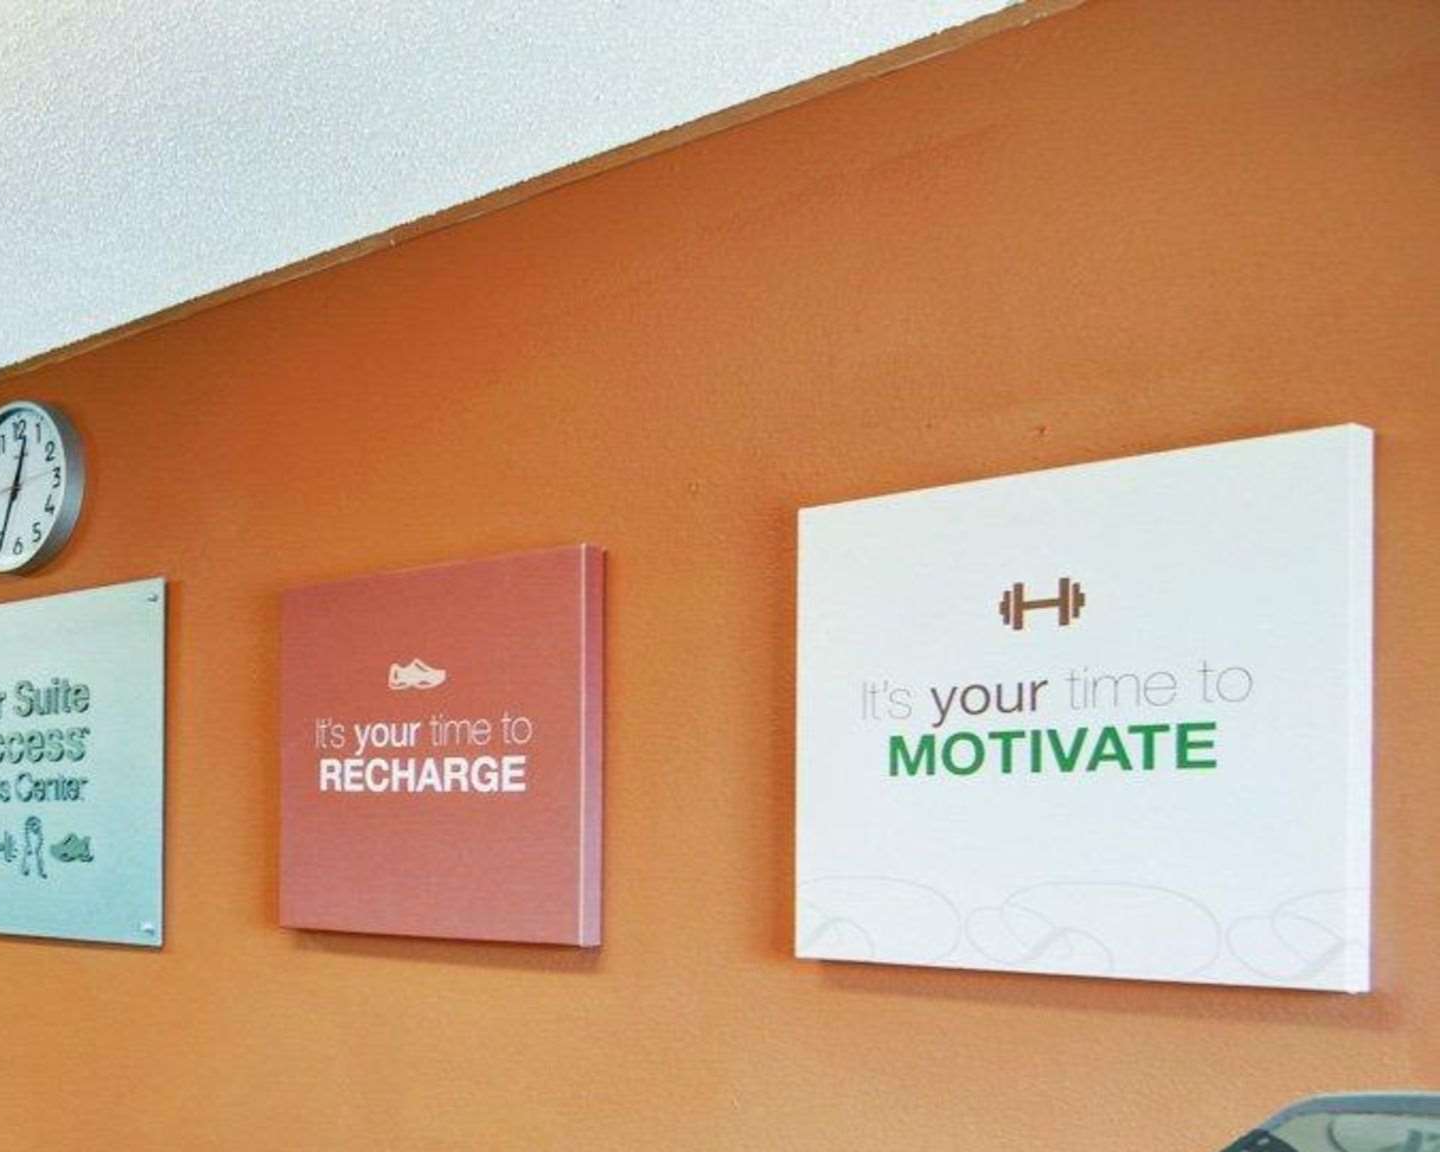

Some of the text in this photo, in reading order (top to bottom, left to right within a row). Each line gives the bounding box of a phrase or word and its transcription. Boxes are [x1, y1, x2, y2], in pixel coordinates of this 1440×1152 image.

[13, 419, 26, 440] 12
[35, 422, 41, 443] 1
[45, 440, 56, 462] 2
[52, 467, 61, 489] 3
[44, 495, 55, 514] 4
[32, 522, 42, 543] 5
[13, 537, 23, 555] 6
[12, 677, 90, 718] Suite
[862, 660, 1253, 728] It's your time to
[315, 712, 533, 756] It's your time to
[887, 721, 1218, 777] MOTIVATE
[319, 755, 527, 793] RECHARGE
[15, 772, 88, 802] Center
